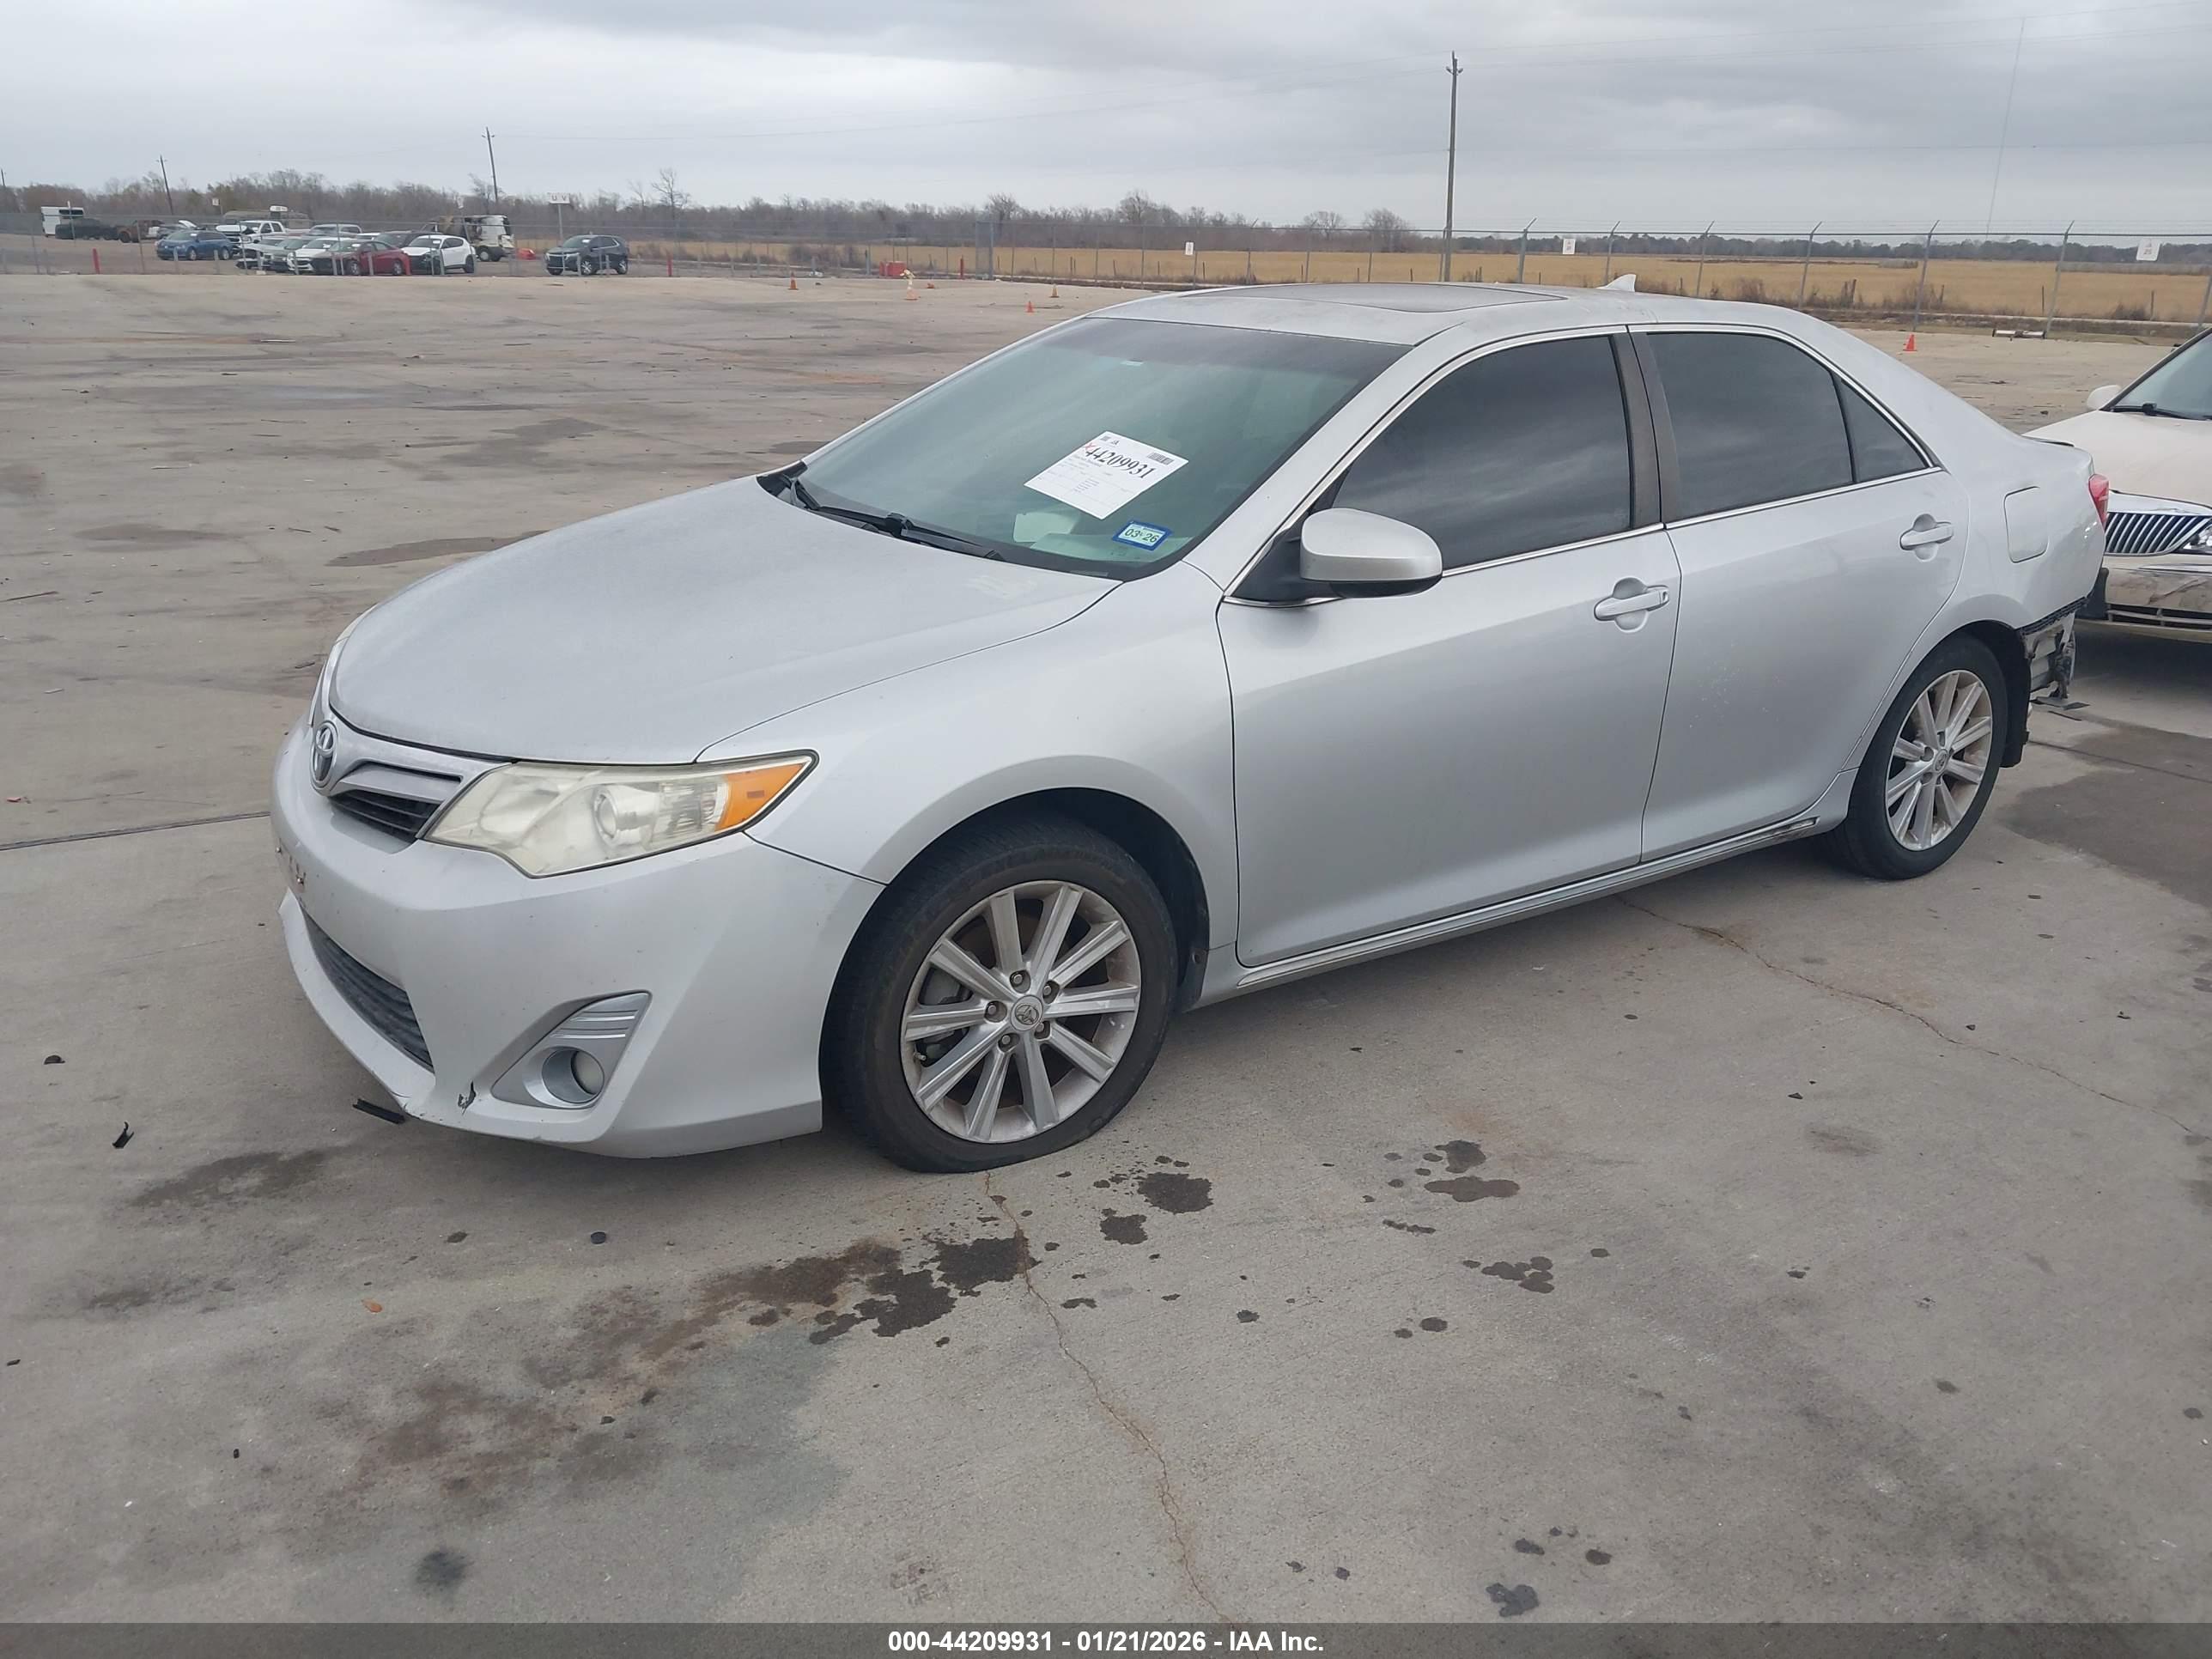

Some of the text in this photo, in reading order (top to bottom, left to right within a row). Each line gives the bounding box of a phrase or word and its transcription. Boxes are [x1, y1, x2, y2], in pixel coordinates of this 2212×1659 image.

[1085, 447, 1157, 479] 44209931
[1124, 528, 1140, 538] 03
[1142, 532, 1160, 544] 26
